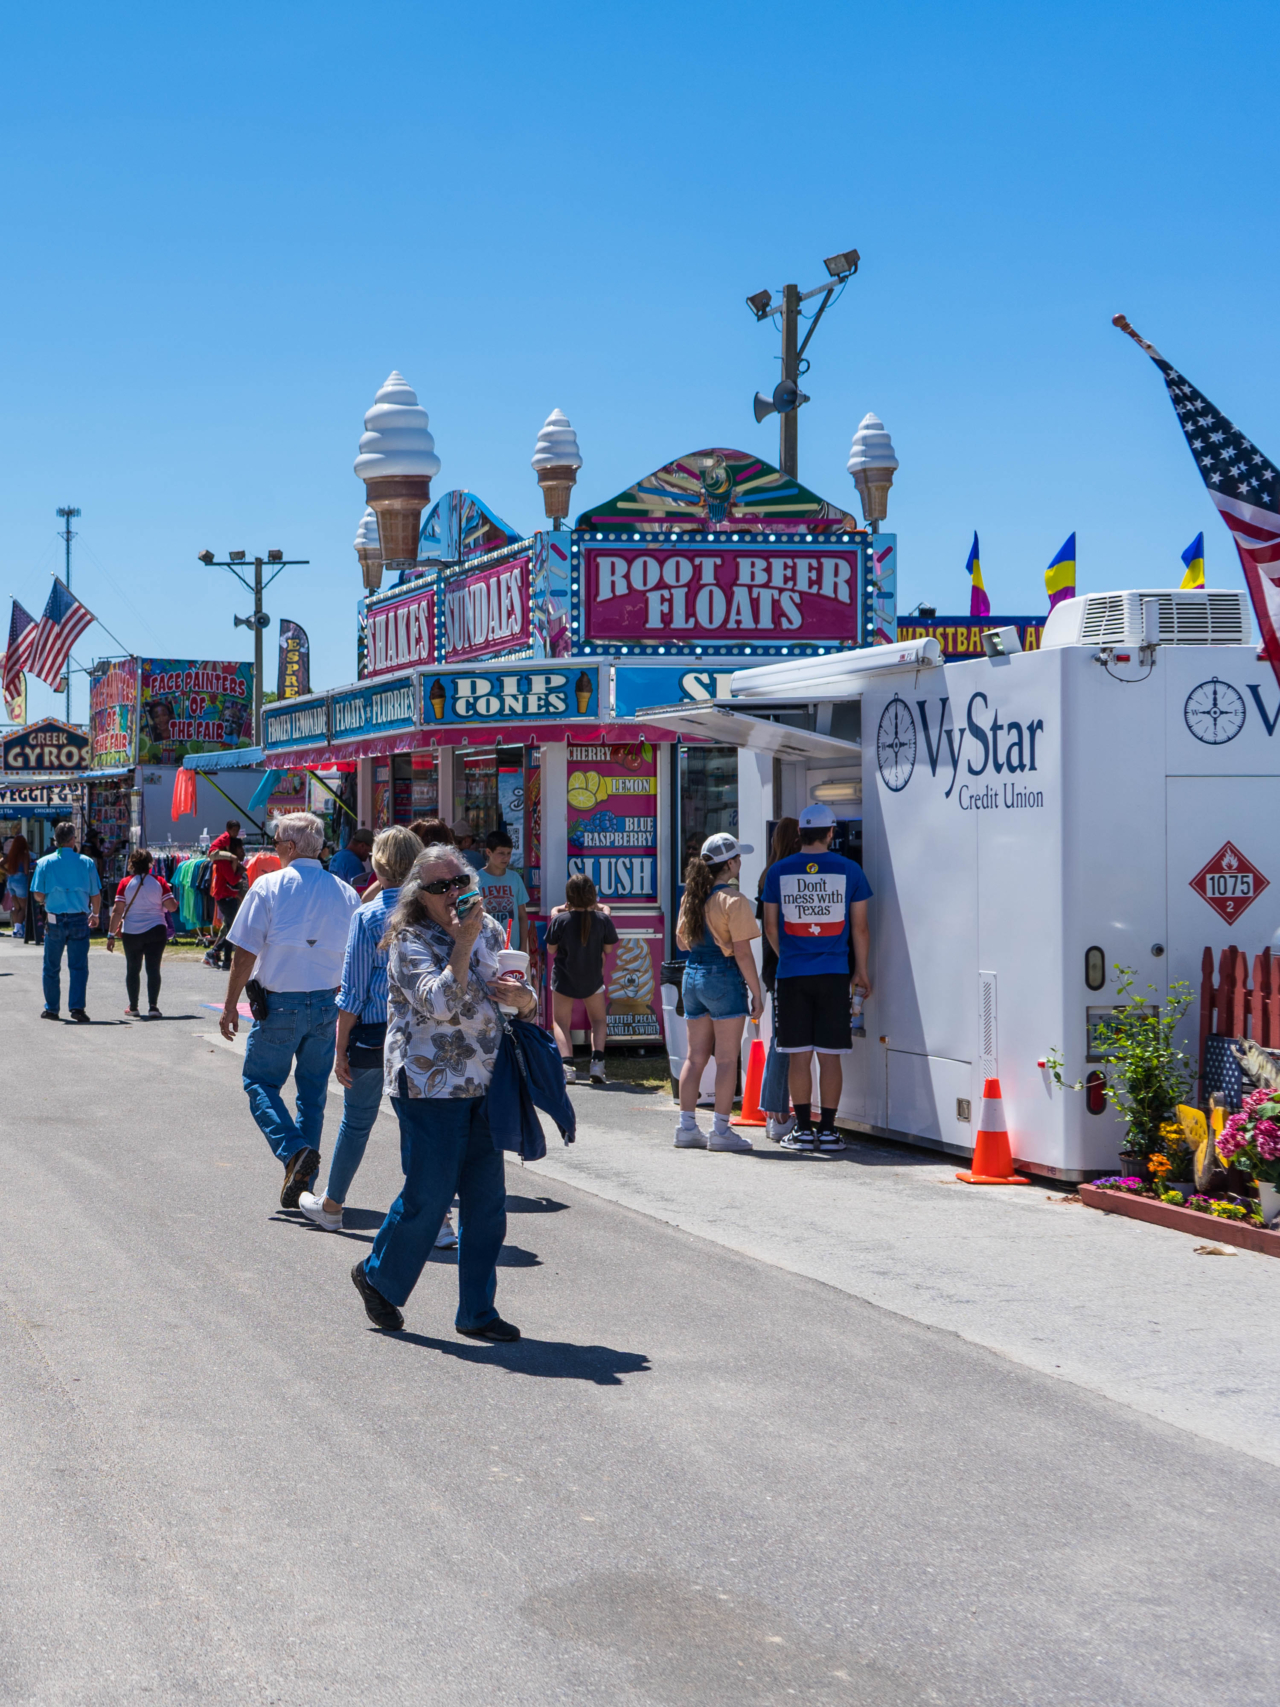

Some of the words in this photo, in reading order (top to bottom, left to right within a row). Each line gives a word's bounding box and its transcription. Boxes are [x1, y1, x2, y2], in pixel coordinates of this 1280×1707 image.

[596, 556, 723, 603] ROOT
[738, 556, 853, 604] BEER
[445, 568, 522, 654] SUNDAES
[646, 586, 803, 630] FLOATS
[367, 597, 429, 672] SHAKES
[897, 626, 1004, 652] WRISTBA
[283, 639, 301, 698] ESPRE
[150, 671, 183, 695] FACE
[184, 670, 247, 697] PAINTERS
[454, 674, 567, 698] DIP
[189, 695, 207, 717] OF
[336, 700, 365, 732] FLOATS
[372, 687, 415, 722] FLURRIES
[454, 693, 567, 717] CONES
[1191, 709, 1200, 717] W
[1234, 709, 1240, 717] E
[170, 720, 194, 741] THE
[196, 720, 225, 742] FAIR
[267, 713, 291, 742] FROZEN
[292, 705, 328, 739] LEMONADE
[29, 732, 68, 745] GREEK
[915, 691, 1044, 799] VyStar
[7, 746, 90, 768] GYROS
[567, 746, 612, 761] CHERRY
[611, 779, 650, 794] LEMON
[958, 784, 1000, 810] Credit
[1003, 782, 1044, 808] Union
[625, 817, 654, 832] BLUE
[583, 832, 654, 847] RASPBERRY
[482, 885, 515, 898] LEVEL
[797, 878, 827, 893] Don't
[1208, 874, 1252, 896] 1075
[783, 893, 815, 904] mess
[816, 889, 843, 904] with
[1226, 901, 1235, 912] 2
[795, 904, 831, 919] Texas
[606, 1014, 633, 1024] BUTTER
[635, 1014, 657, 1023] PECAN
[606, 1025, 634, 1035] VANILLA
[635, 1025, 657, 1034] SWIRL
